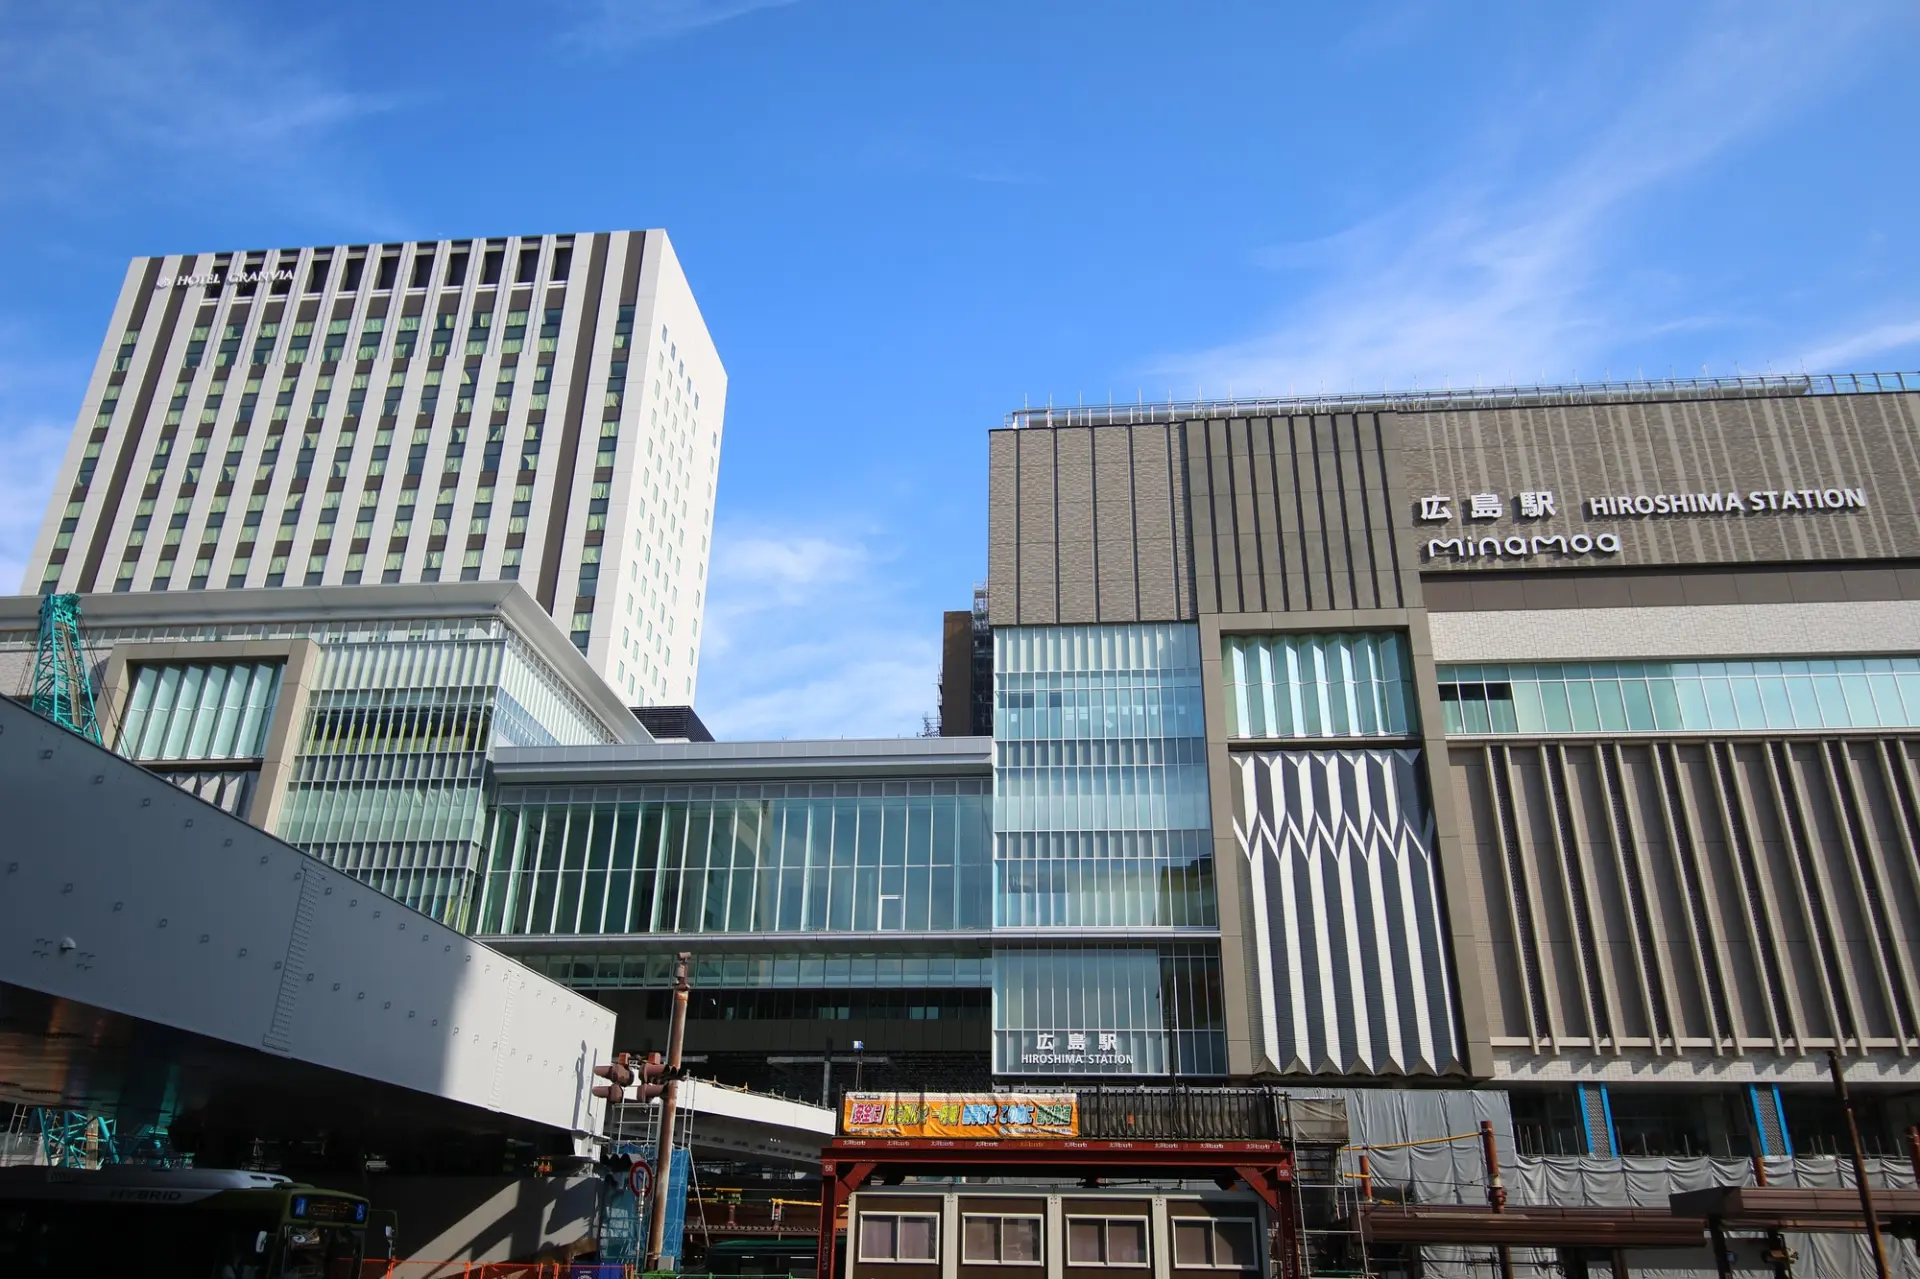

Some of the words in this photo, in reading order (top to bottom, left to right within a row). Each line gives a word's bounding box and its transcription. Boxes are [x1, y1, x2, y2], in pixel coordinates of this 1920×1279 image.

[176, 273, 221, 286] HOTEL
[228, 269, 295, 284] GRANVIA
[1420, 490, 1556, 520] 広島駅
[1590, 492, 1744, 516] HIROSHIMA
[1748, 487, 1867, 511] STATION
[1427, 533, 1621, 559] minamoa
[1036, 1032, 1117, 1050] 広島駅
[1021, 1053, 1083, 1064] HIROSHIMA
[1088, 1053, 1134, 1064] STATION
[110, 1188, 182, 1202] HYBRID
